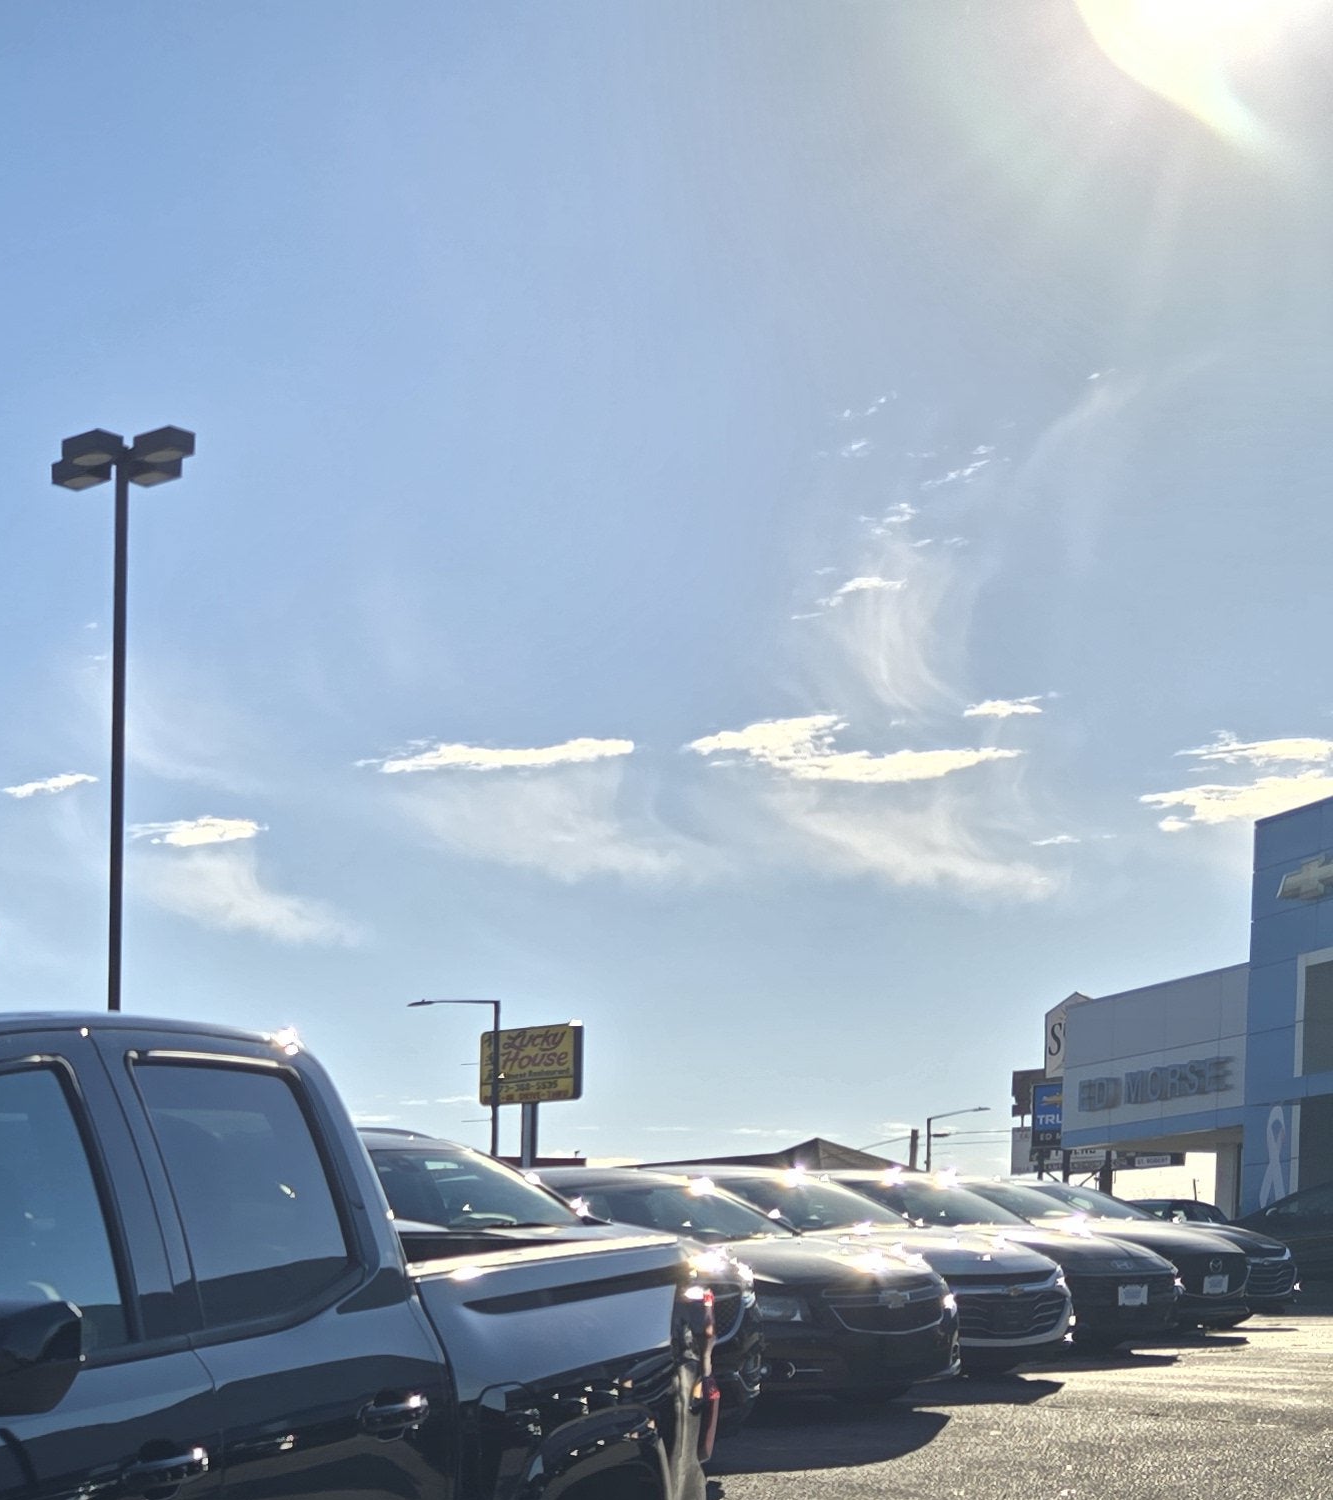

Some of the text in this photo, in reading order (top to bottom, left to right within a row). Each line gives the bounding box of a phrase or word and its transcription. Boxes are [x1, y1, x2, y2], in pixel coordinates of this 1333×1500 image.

[502, 1030, 567, 1052] Lucky
[500, 1051, 568, 1070] House
[1077, 1055, 1235, 1112] ED MORSE
